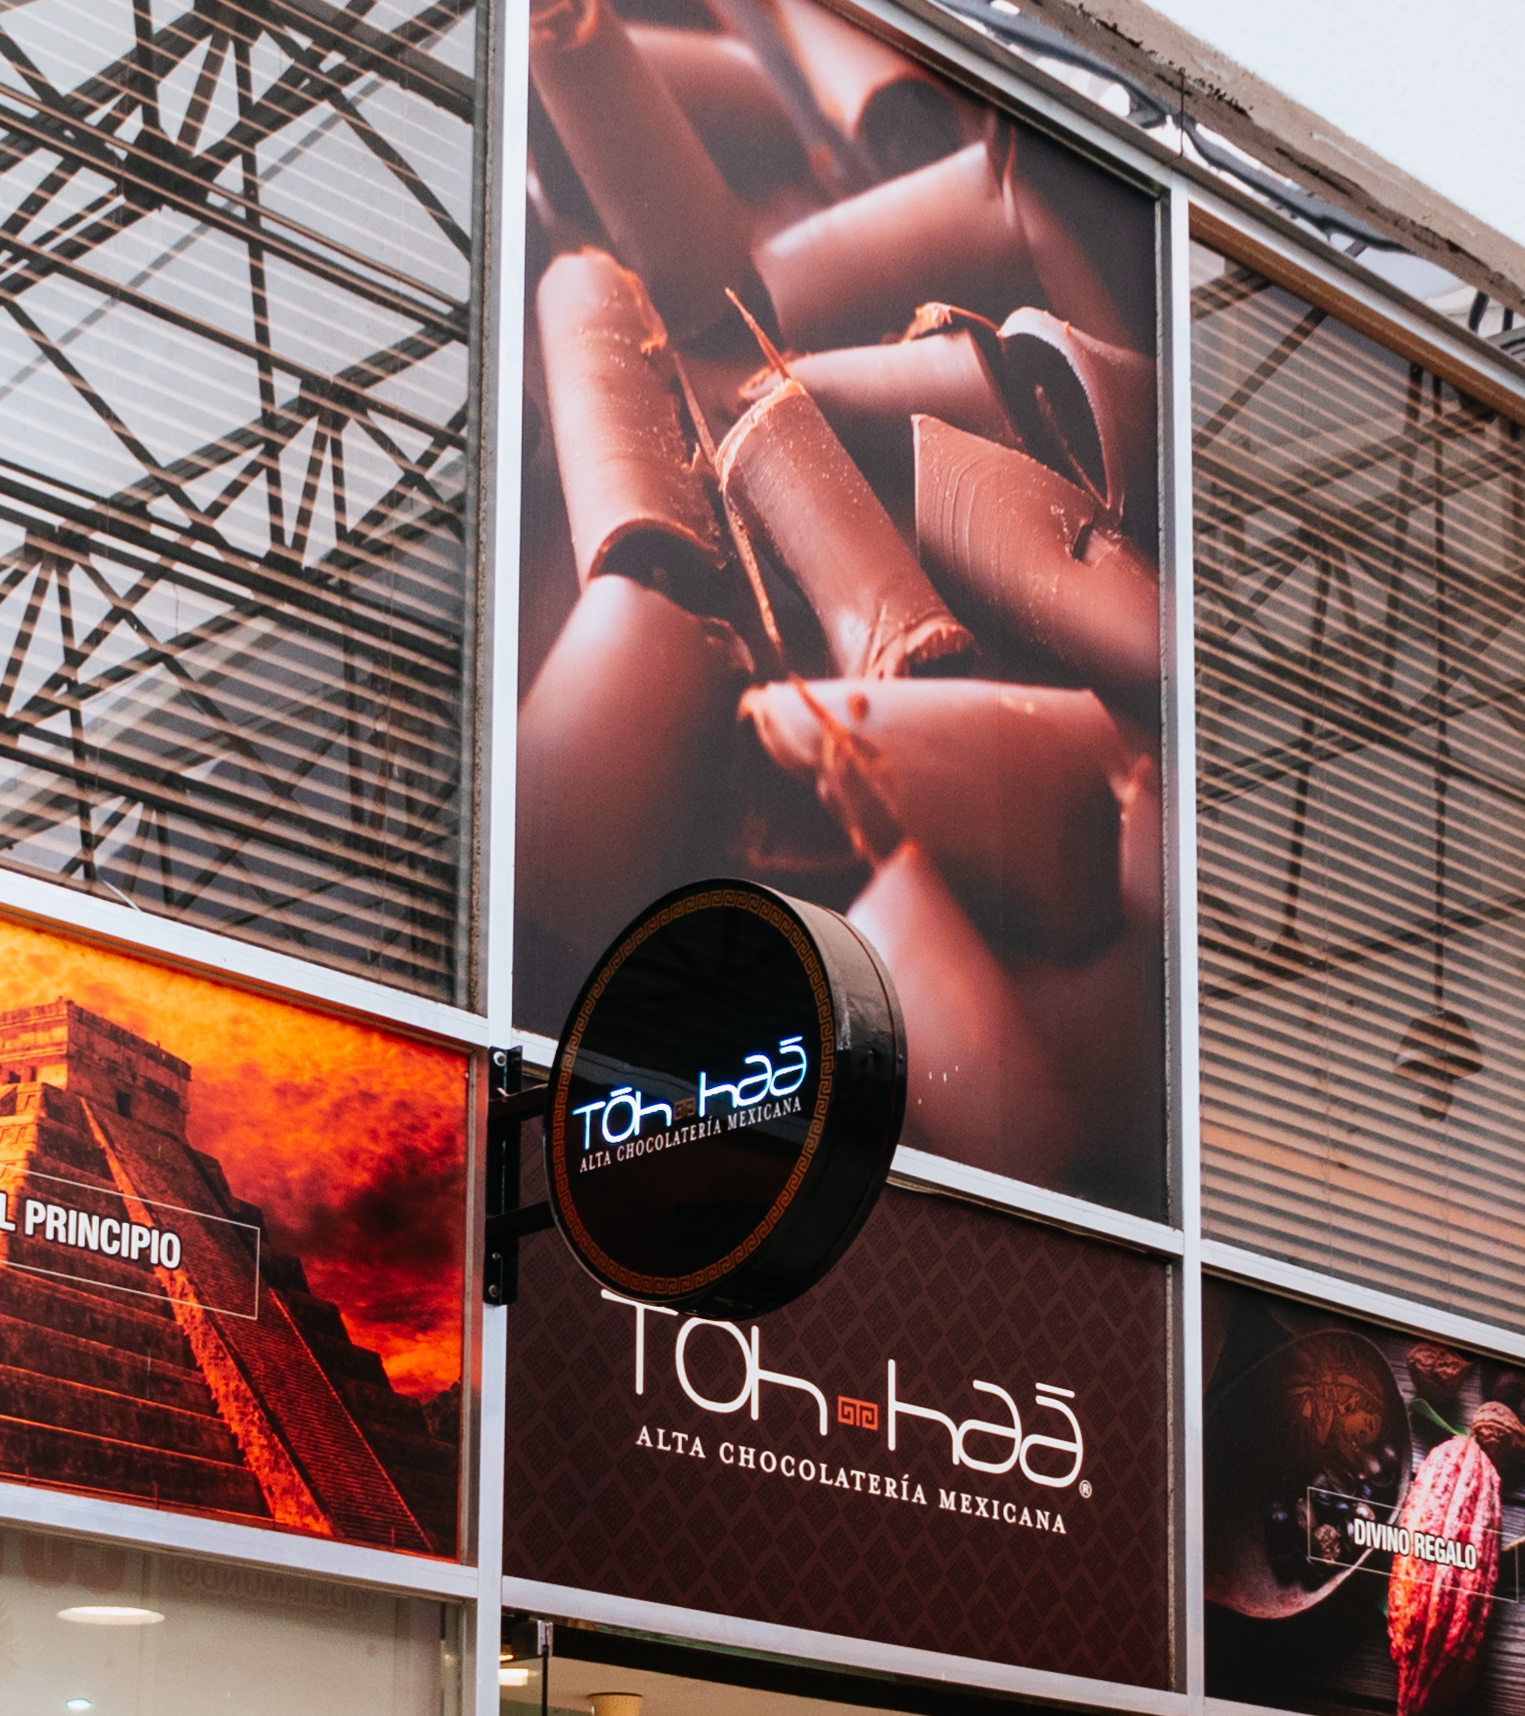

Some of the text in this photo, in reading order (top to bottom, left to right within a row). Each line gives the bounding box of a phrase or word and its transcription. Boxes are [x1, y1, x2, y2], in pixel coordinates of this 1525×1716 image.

[579, 1096, 802, 1173] ALTA CHOCOLATERÍA MEXICANA
[25, 1199, 181, 1269] PRINCIPIO
[636, 1426, 1067, 1534] ALTA CHOCOLATERÍA MEXICANA
[1354, 1518, 1477, 1570] DIVINO REGALO
